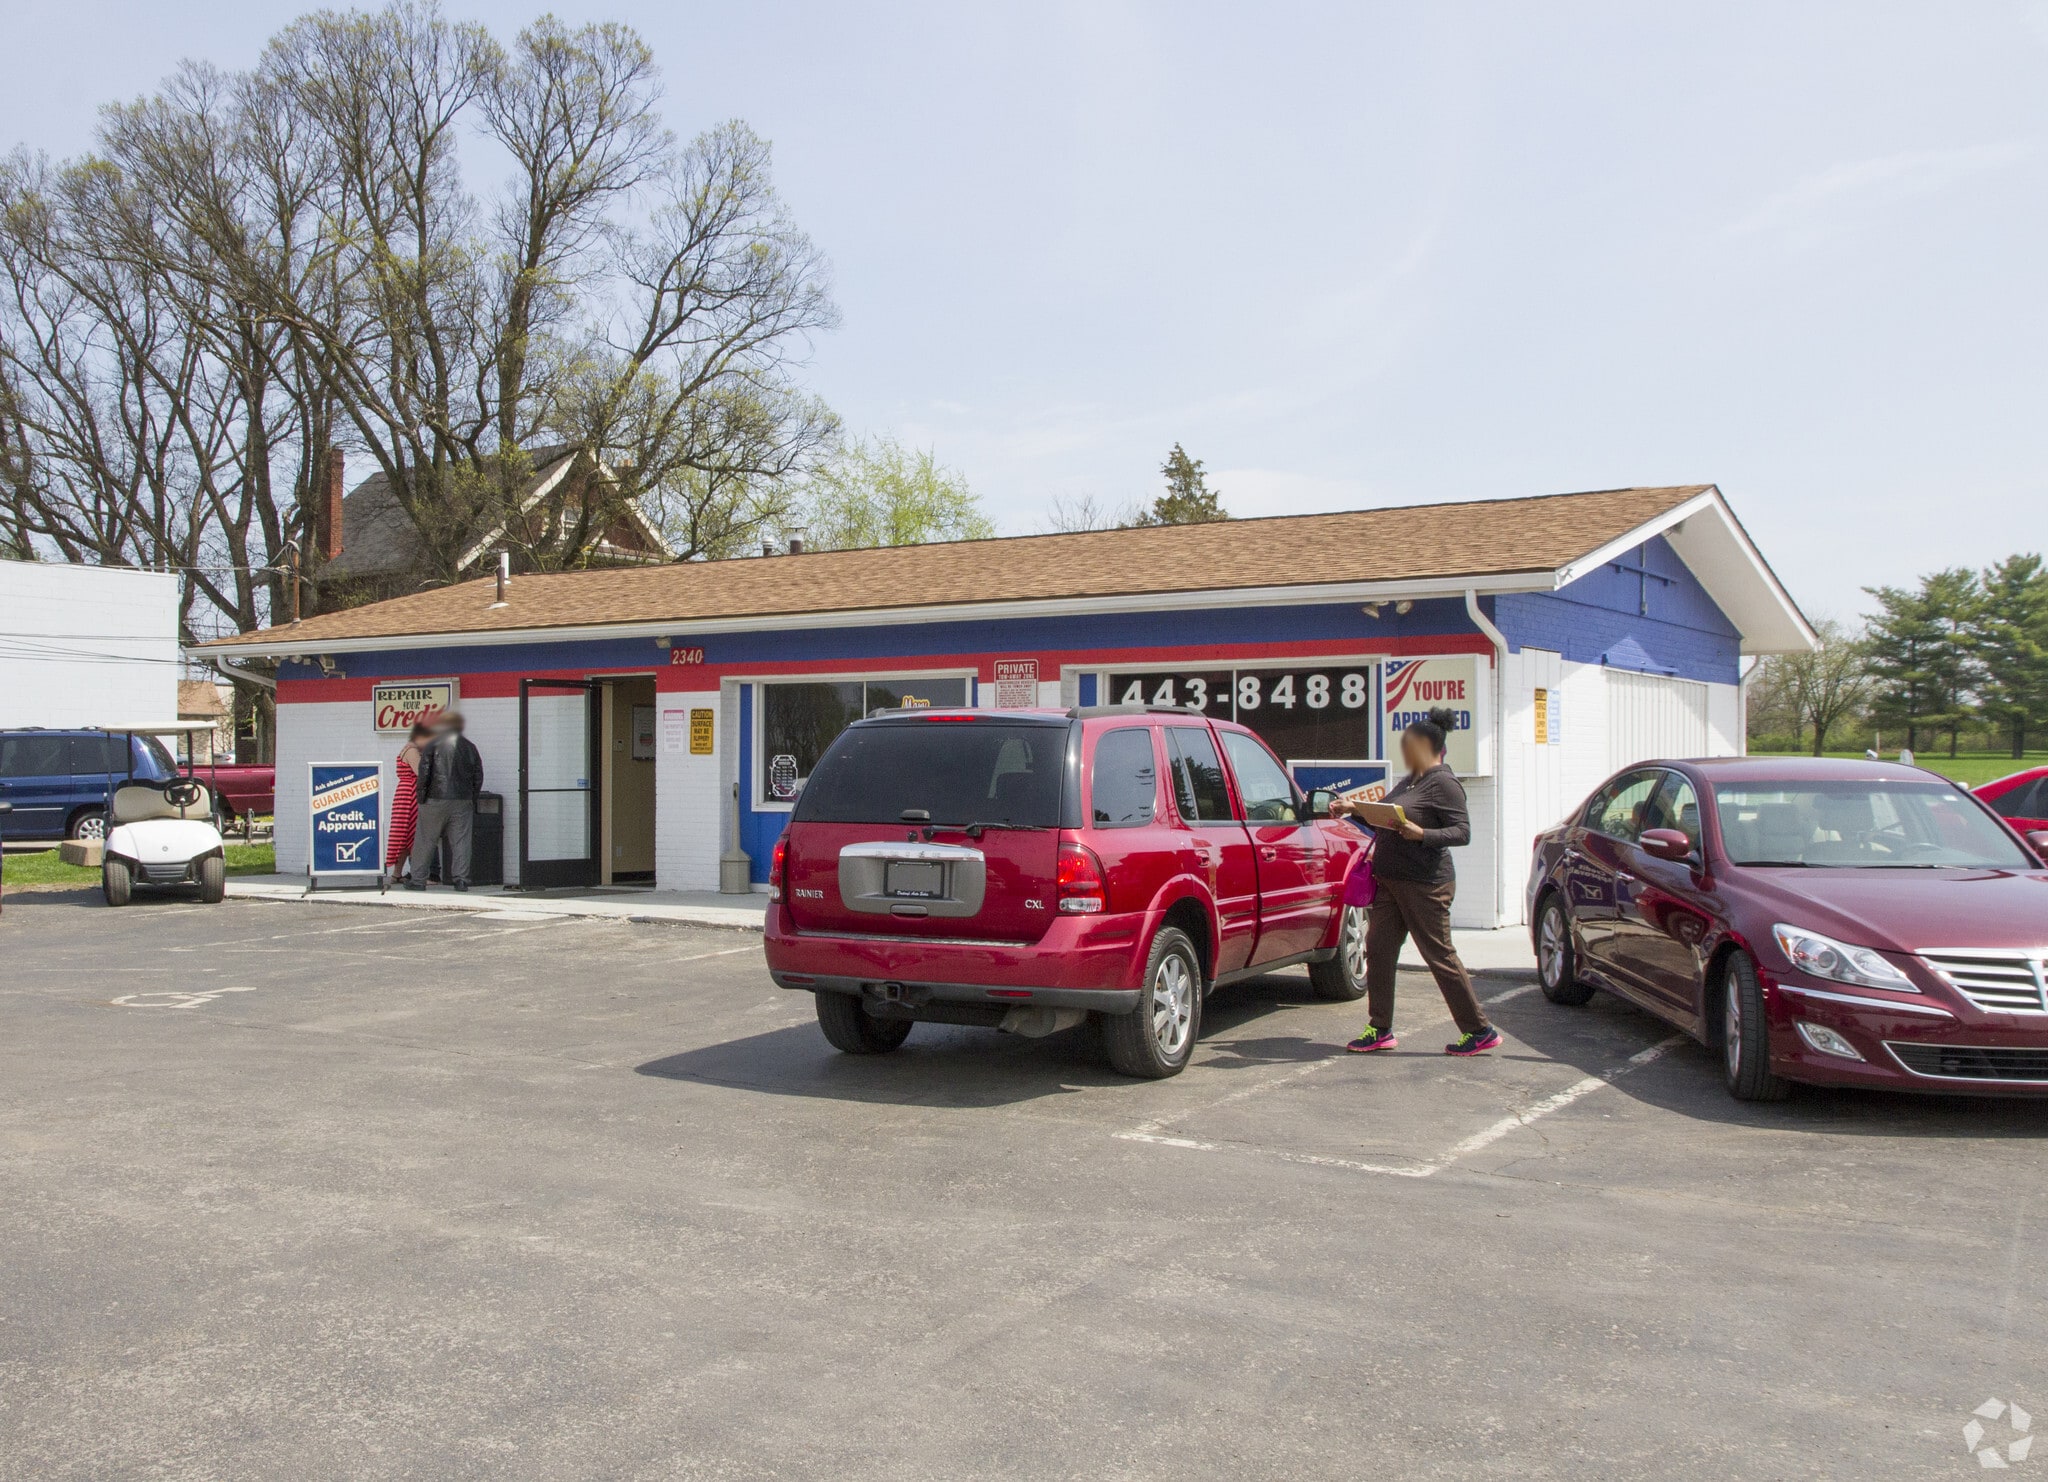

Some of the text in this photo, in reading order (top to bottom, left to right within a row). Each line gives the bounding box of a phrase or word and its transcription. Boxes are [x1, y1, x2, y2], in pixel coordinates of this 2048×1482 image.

[672, 649, 704, 664] 2340
[997, 663, 1035, 674] PRIVATE
[377, 689, 432, 701] REPAIR
[1121, 673, 1366, 711] 443-8488
[1413, 679, 1466, 701] YOU'RE
[403, 701, 421, 710] YOUR
[691, 710, 712, 719] CAUTION
[1392, 710, 1471, 731] APPED
[315, 774, 354, 791] Ask about our
[1337, 778, 1352, 788] our
[312, 778, 379, 809] GUARANTEED
[327, 810, 365, 821] Credit
[318, 819, 376, 832] Approval!
[795, 888, 824, 899] RAINIER
[1024, 899, 1045, 909] CXL
